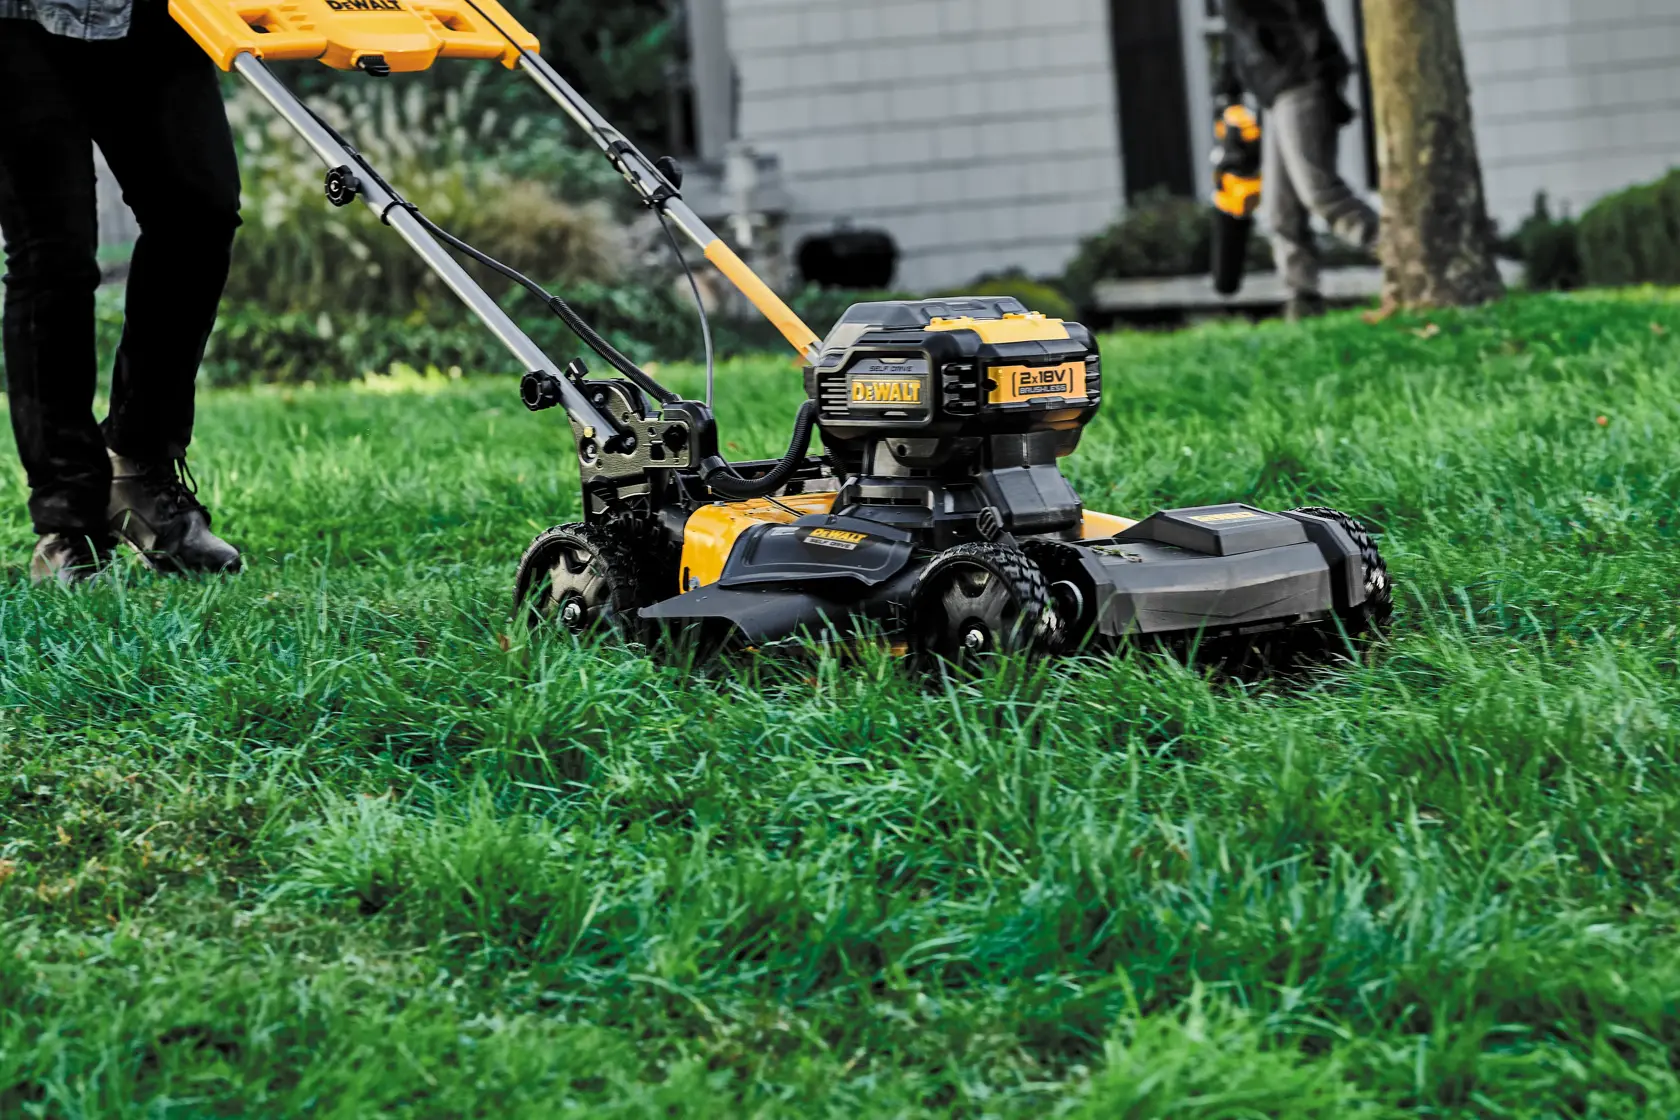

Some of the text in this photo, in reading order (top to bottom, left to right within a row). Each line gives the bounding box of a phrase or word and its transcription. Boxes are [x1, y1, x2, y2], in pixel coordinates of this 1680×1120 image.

[1020, 369, 1066, 384] 2x18V
[852, 381, 921, 401] DEWALT
[1019, 384, 1067, 394] BRUSHLESS
[809, 528, 868, 543] DEWALT
[829, 541, 851, 549] DRIVE
